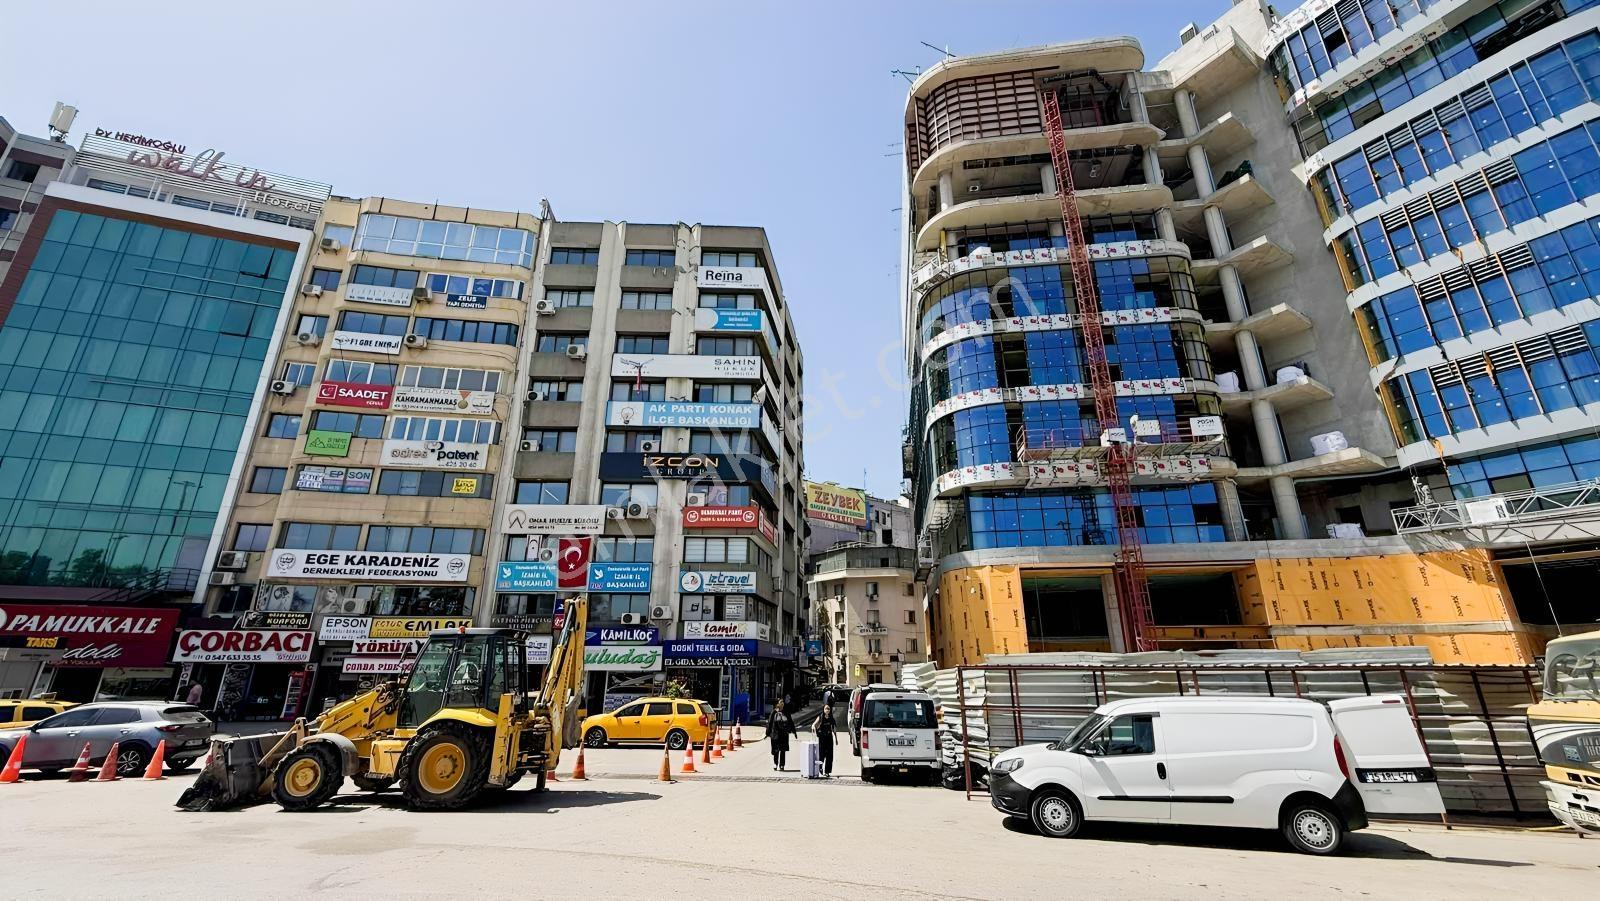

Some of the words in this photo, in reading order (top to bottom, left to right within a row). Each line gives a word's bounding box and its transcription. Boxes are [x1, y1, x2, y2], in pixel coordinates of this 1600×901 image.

[127, 148, 227, 183] walk
[254, 190, 314, 213] Hotel
[338, 387, 389, 400] SAADET
[649, 404, 667, 412] AK
[709, 405, 752, 413] KONAK
[436, 449, 480, 461] patent
[329, 470, 371, 480] EPSON
[814, 489, 861, 511] ZEYBEK
[304, 553, 340, 565] EGE
[344, 554, 441, 568] KARADENİZ
[302, 567, 366, 576] DERNEKLERİ
[367, 568, 438, 577] FEDERASYONU
[5, 614, 162, 634] PAMUKKALE
[326, 618, 368, 628] EPSON
[26, 636, 59, 648] TAKSİ
[179, 631, 313, 657] ÇORBACI
[695, 644, 719, 652] TEKEL
[62, 642, 124, 659] dolu
[585, 648, 662, 669] uludağ
